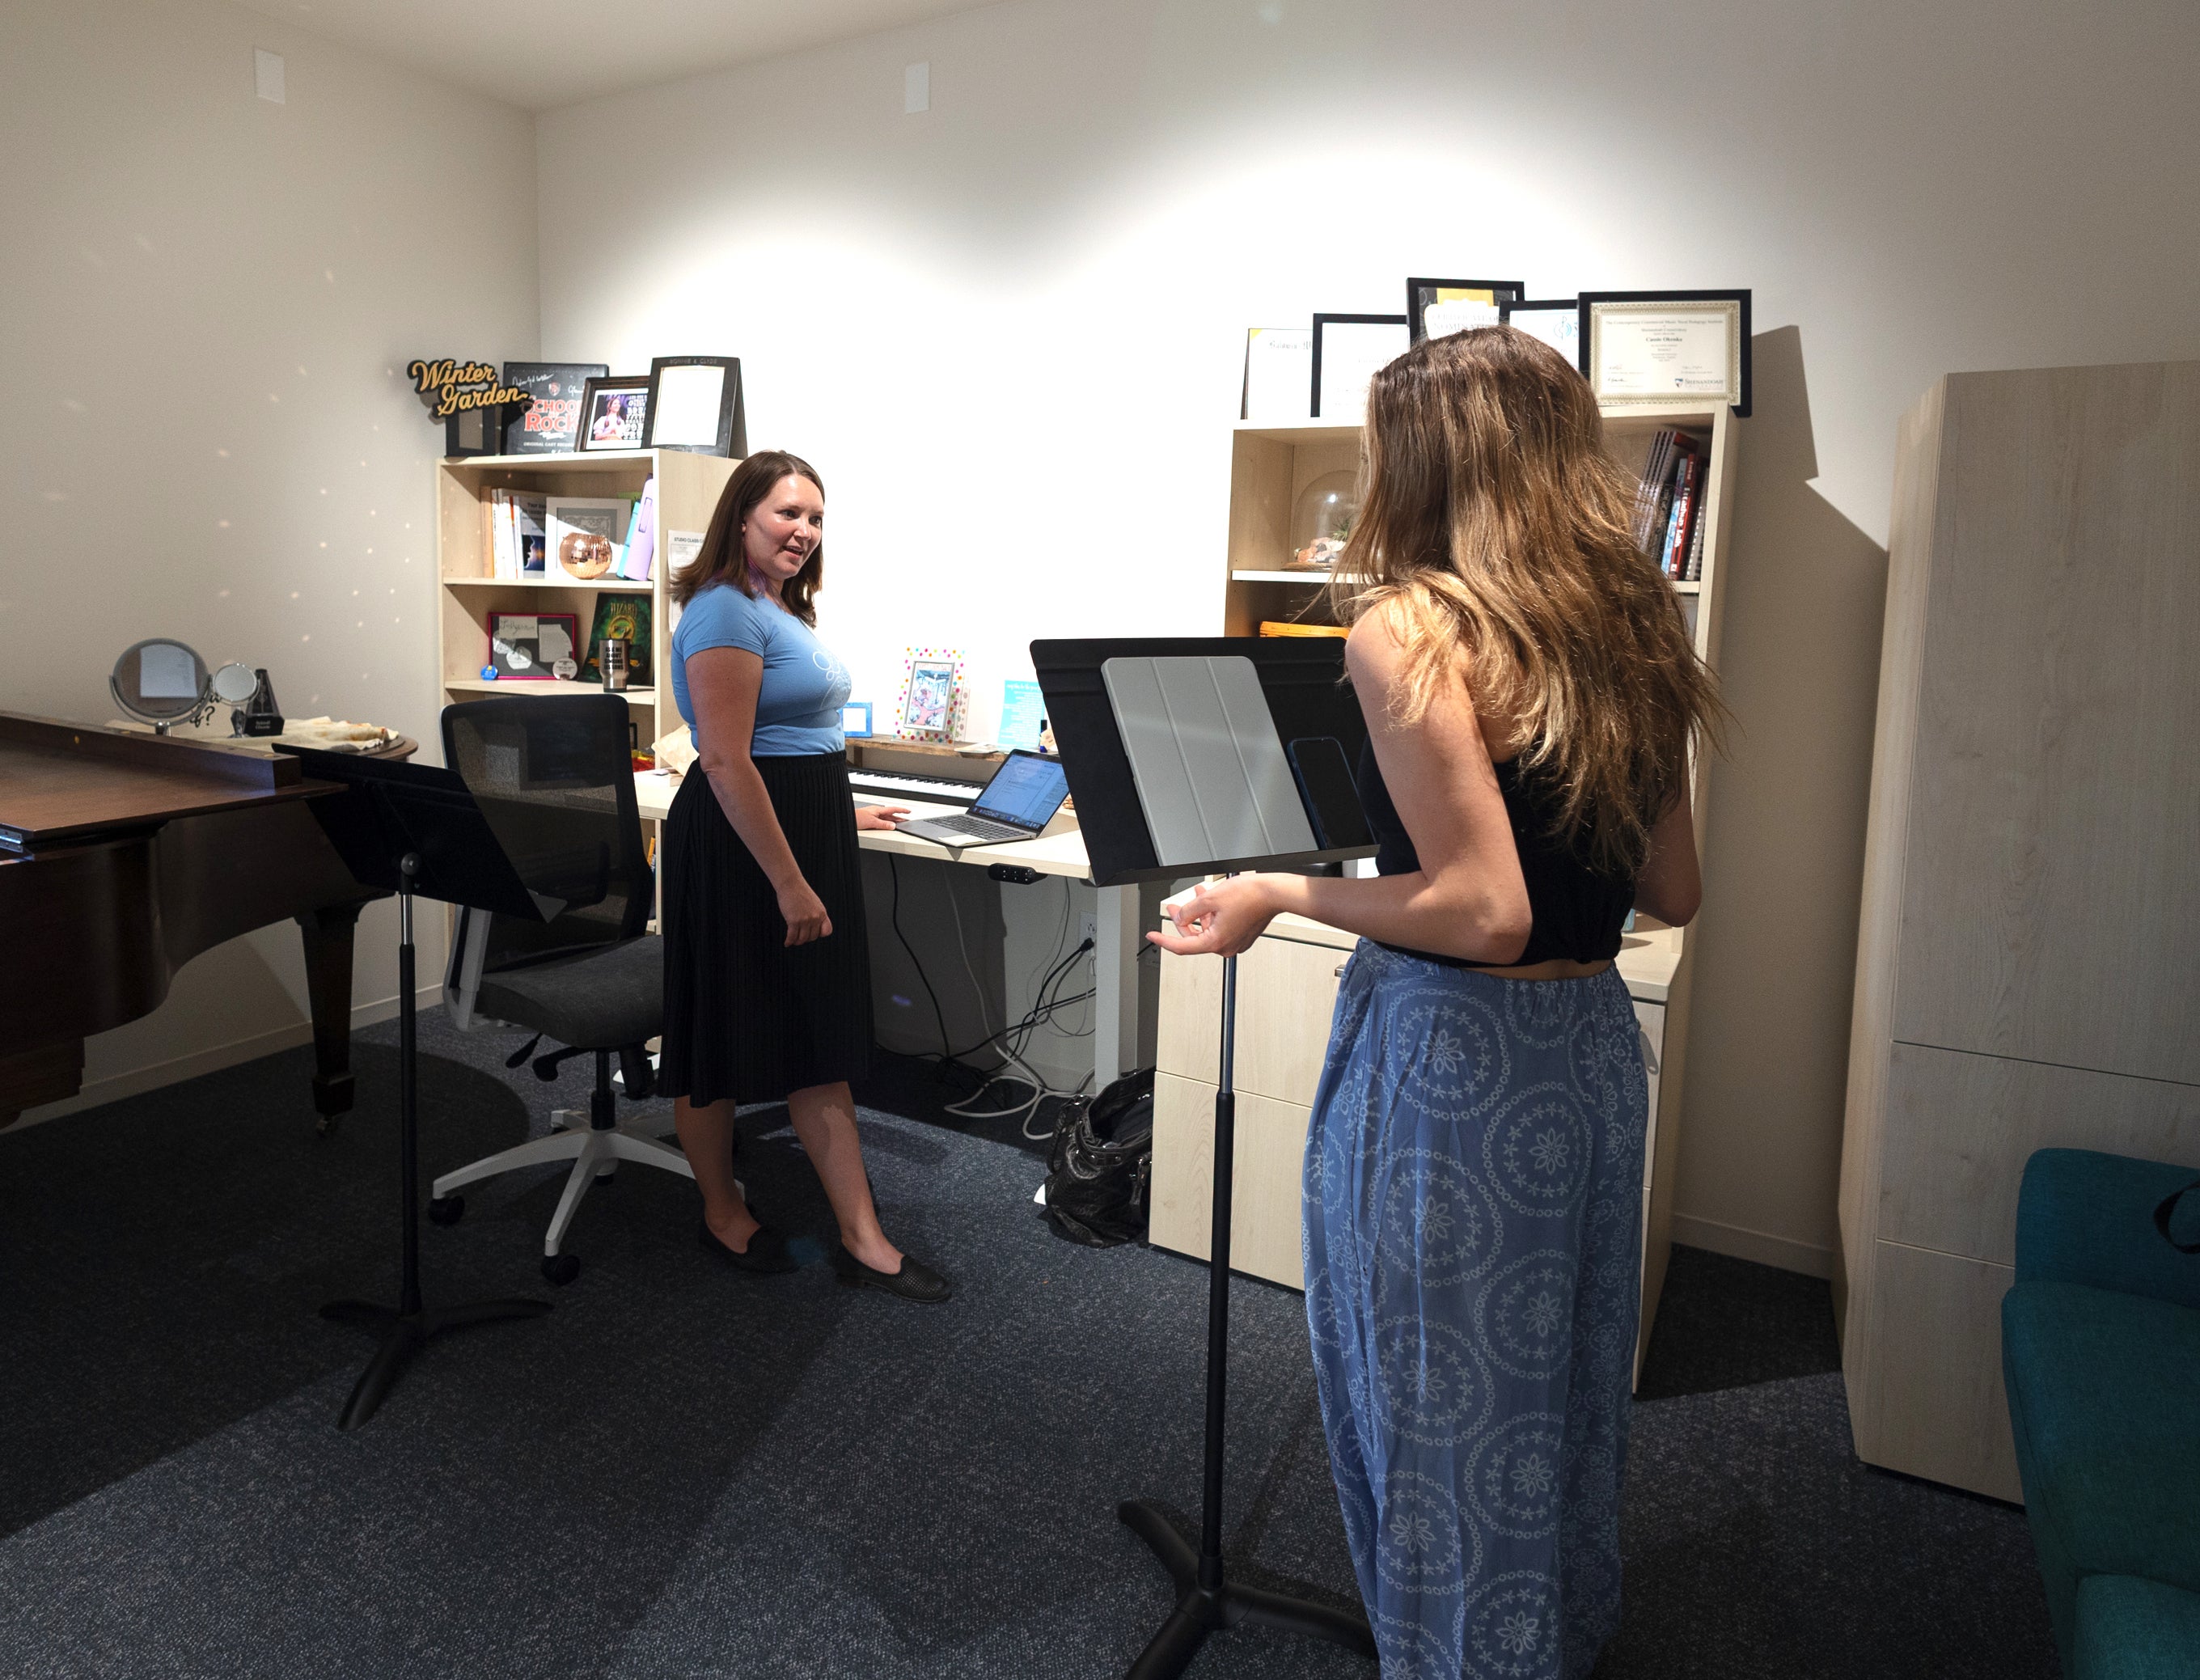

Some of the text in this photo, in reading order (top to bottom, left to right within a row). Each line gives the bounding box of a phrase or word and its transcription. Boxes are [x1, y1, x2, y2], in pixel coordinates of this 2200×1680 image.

[412, 360, 497, 391] Winter
[437, 382, 530, 417] Garden
[524, 412, 580, 433] ROCK
